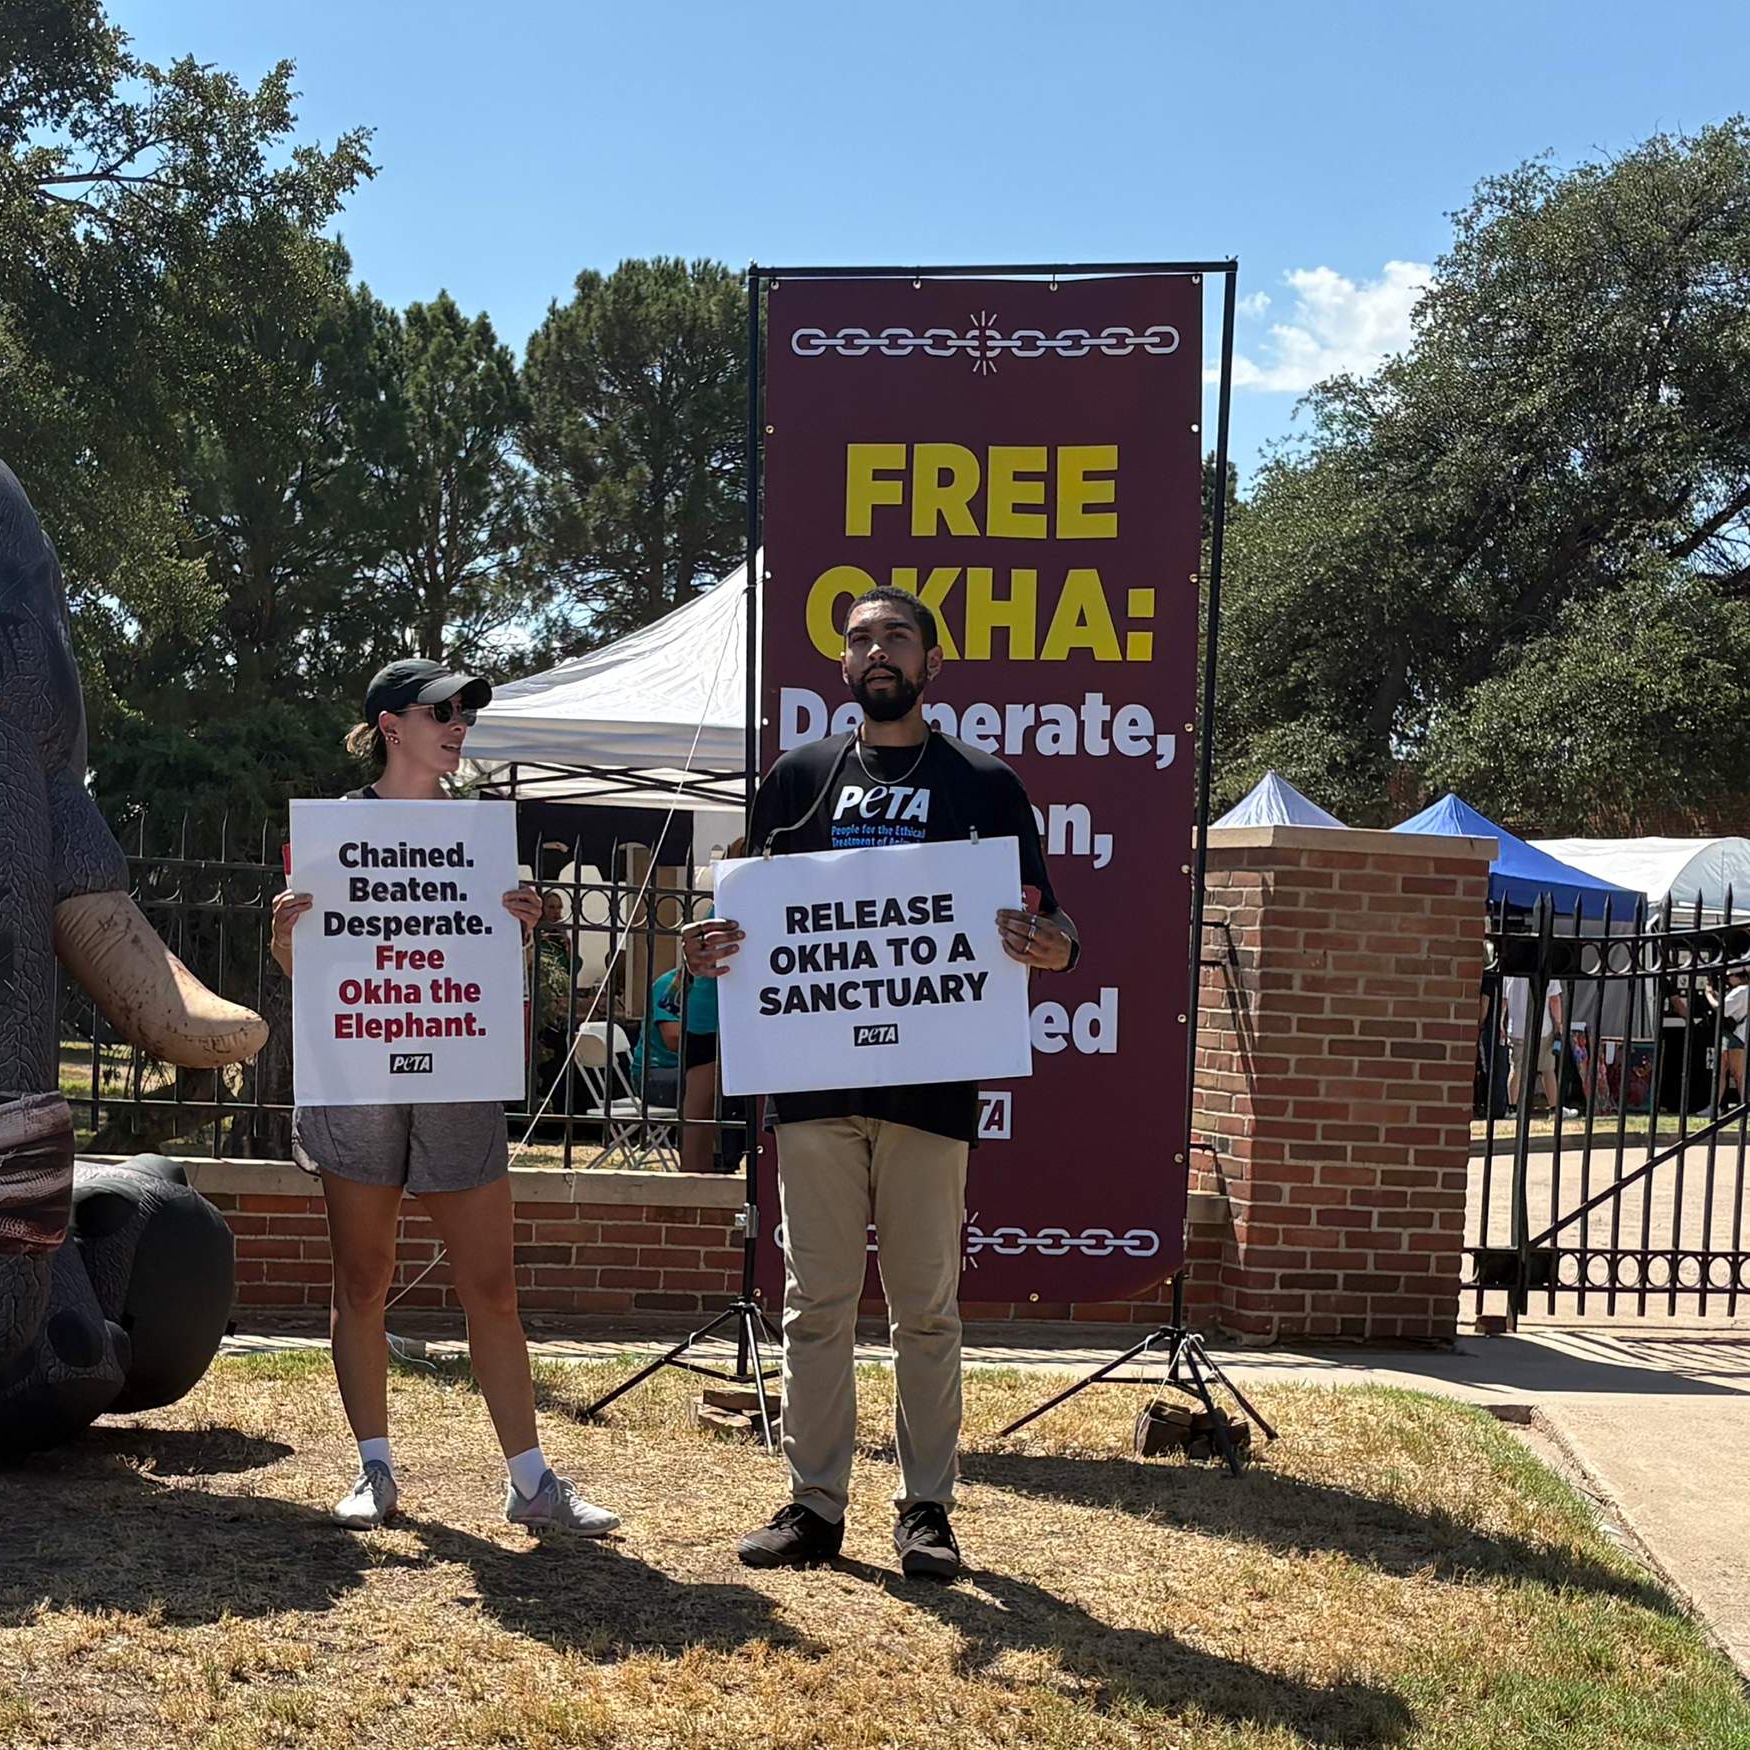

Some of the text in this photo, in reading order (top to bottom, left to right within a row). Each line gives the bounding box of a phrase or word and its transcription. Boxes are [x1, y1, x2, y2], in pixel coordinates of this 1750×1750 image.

[845, 443, 1119, 539] FREE
[806, 565, 1155, 661] OKHA:
[779, 687, 1176, 770] Deerate,
[833, 785, 930, 823] PeTA
[832, 824, 926, 839] People for the Ethical
[832, 838, 874, 850] Treatment
[877, 837, 888, 847] of
[339, 841, 475, 868] Chained.
[350, 877, 468, 902] Beaten.
[324, 911, 493, 941] Desperate.
[786, 894, 955, 934] RELEASE
[376, 945, 445, 970] Free
[770, 933, 976, 976] OKHA TO A
[339, 977, 481, 1004] Okha the
[759, 972, 989, 1015] SANCTUARY
[335, 1012, 487, 1043] Elephant.
[857, 1026, 896, 1044] PeTA
[393, 1055, 430, 1071] PeTA
